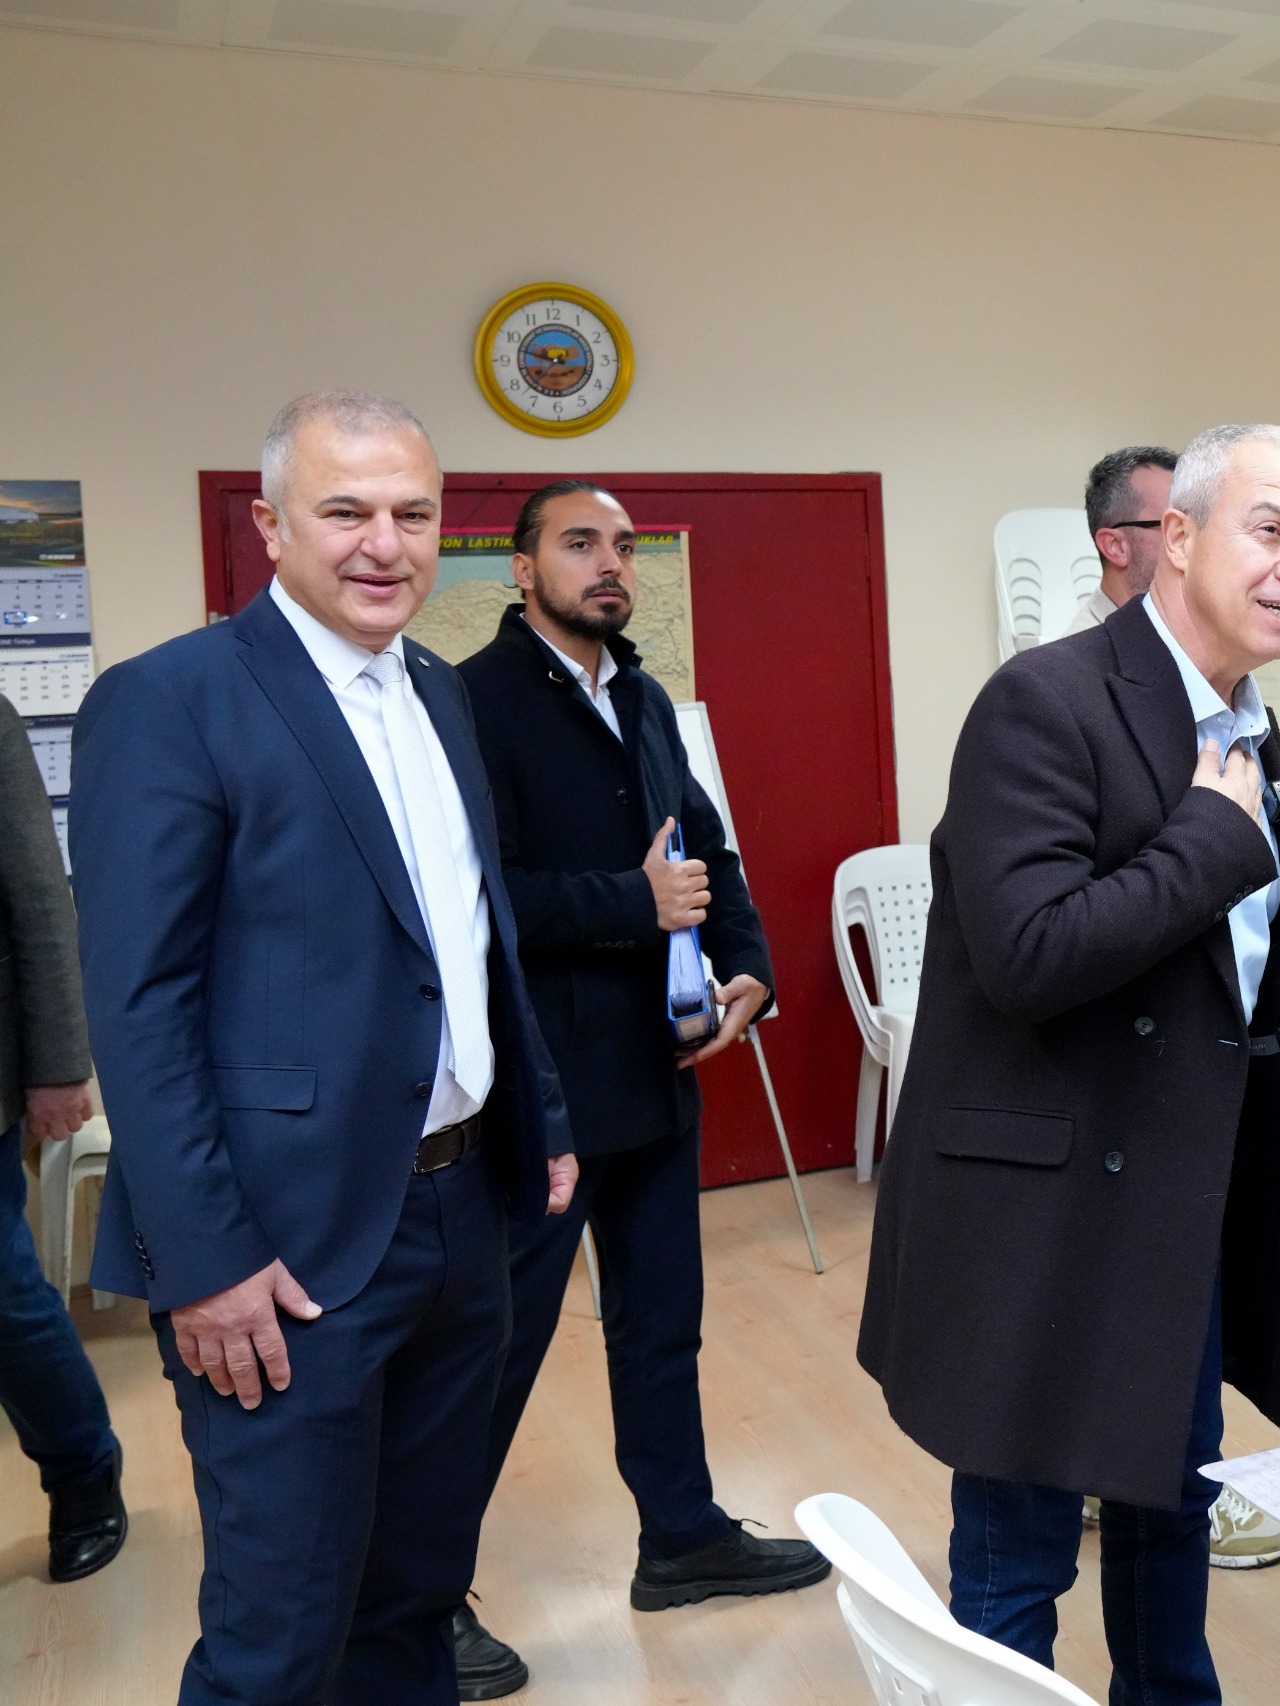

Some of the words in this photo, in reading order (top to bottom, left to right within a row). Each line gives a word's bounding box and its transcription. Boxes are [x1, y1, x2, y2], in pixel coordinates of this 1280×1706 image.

[526, 314, 537, 326] 11
[546, 308, 561, 321] 12
[507, 331, 522, 343] 10
[592, 332, 601, 344] 2
[500, 354, 511, 366] 9
[600, 355, 610, 367] 3
[510, 379, 520, 391] 8
[594, 378, 602, 391] 4
[529, 395, 539, 408] 7
[577, 395, 587, 407] 5
[553, 401, 563, 414] 6
